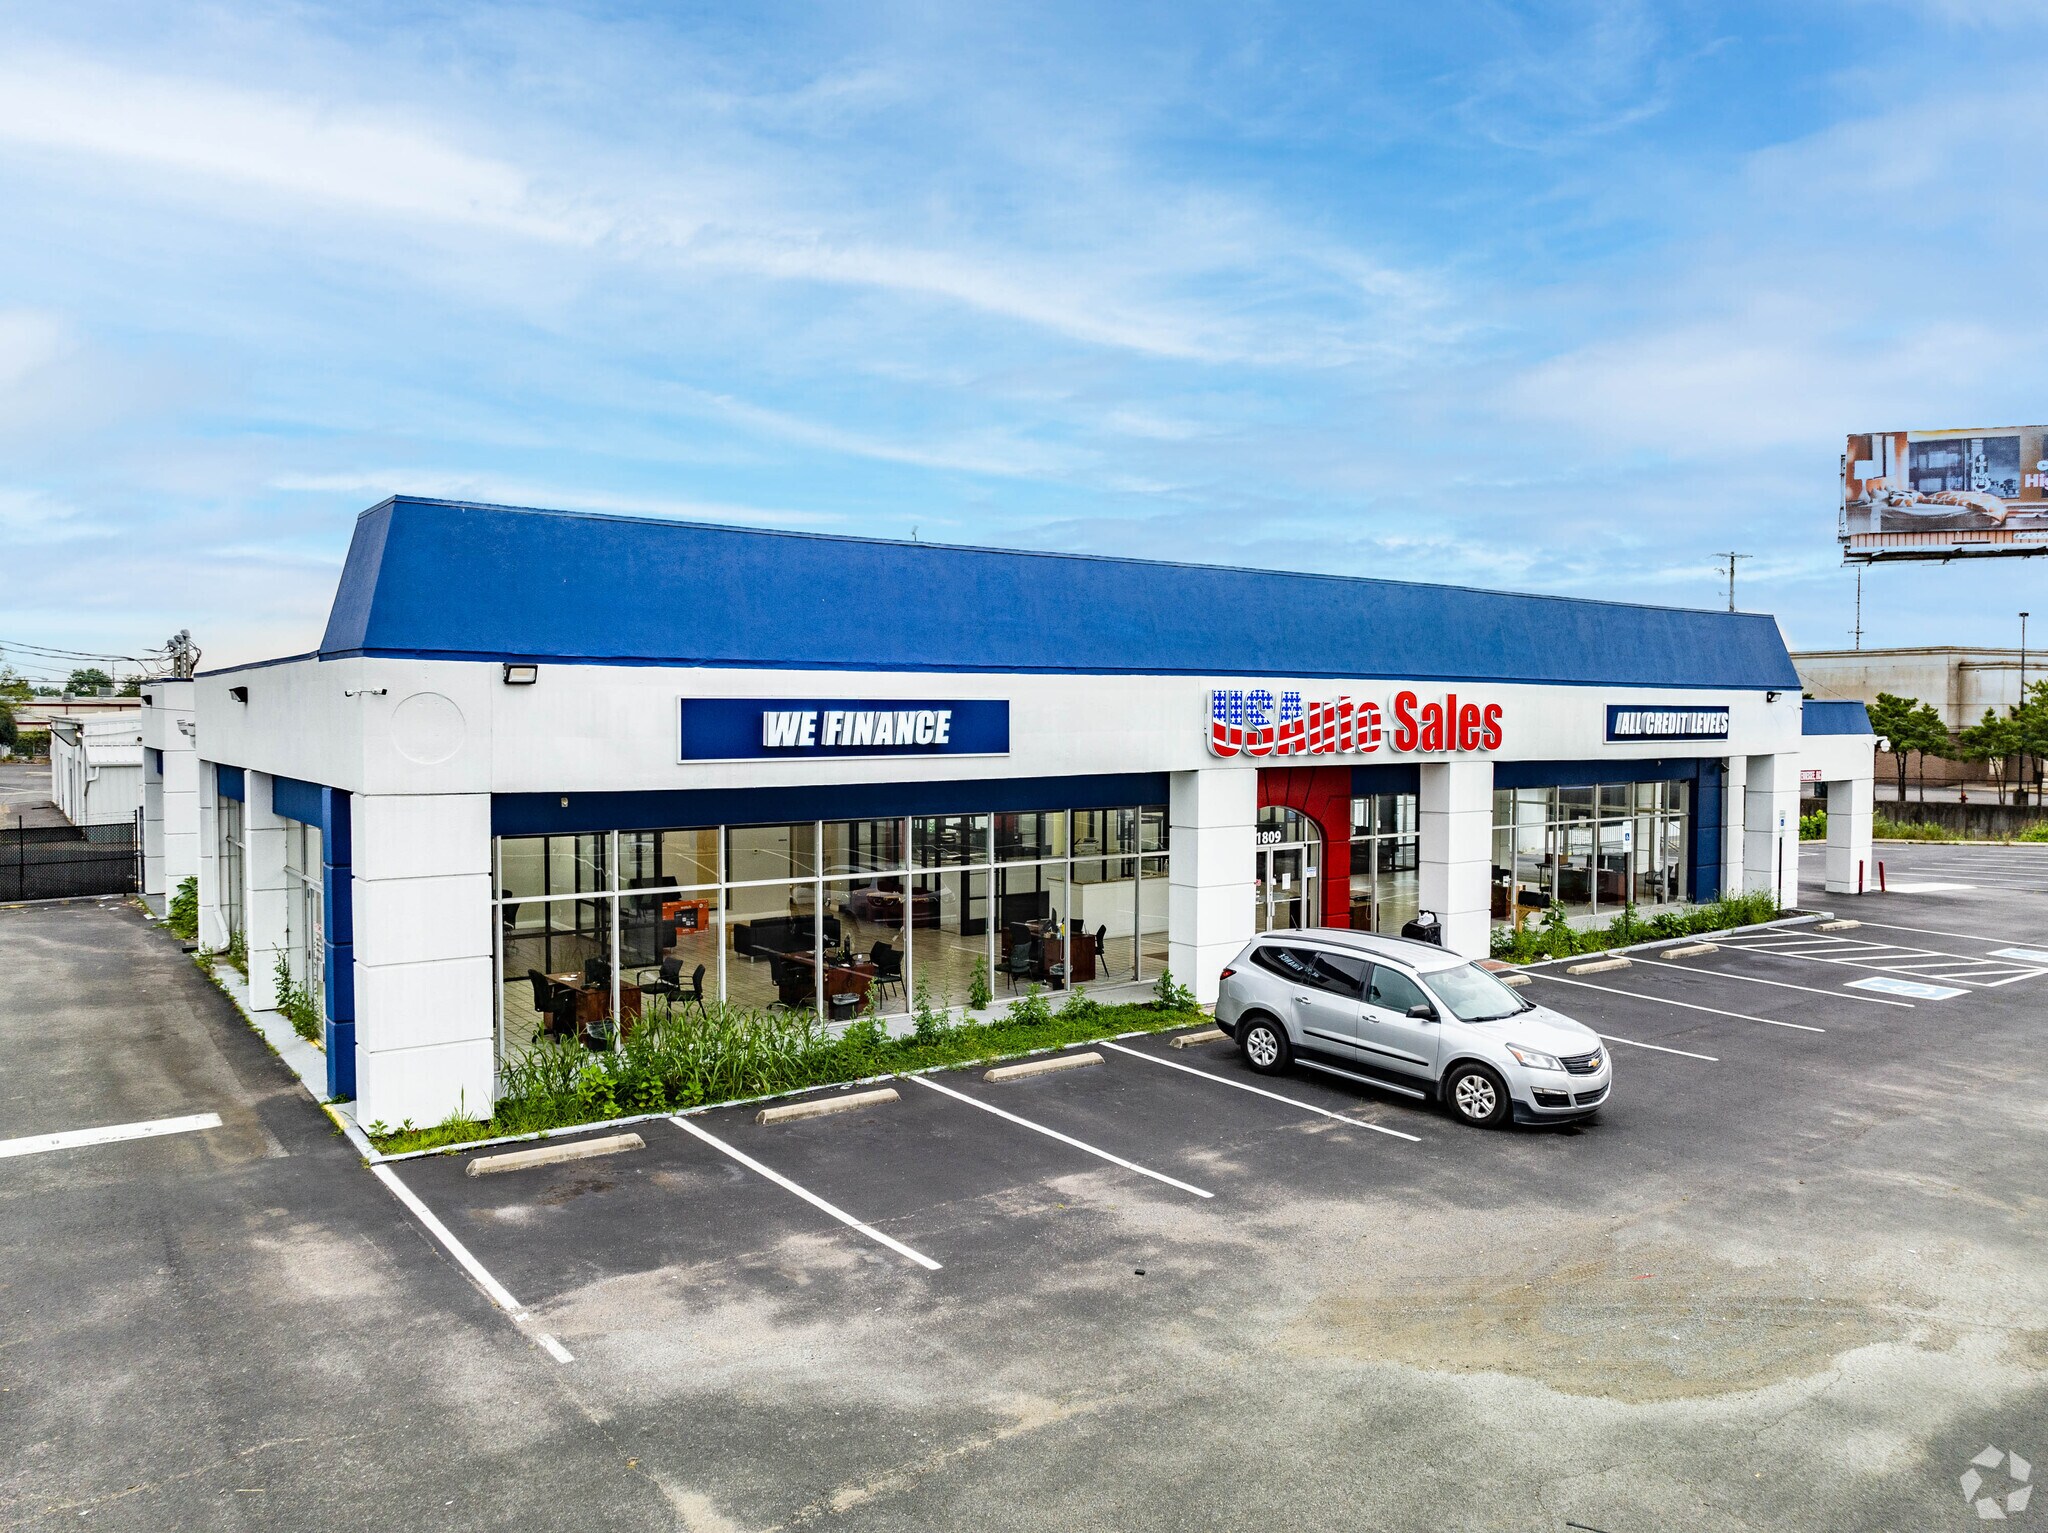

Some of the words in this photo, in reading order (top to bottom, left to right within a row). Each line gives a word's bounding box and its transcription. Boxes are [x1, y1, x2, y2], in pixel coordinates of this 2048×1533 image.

[763, 711, 817, 746] WE
[822, 710, 952, 746] FINANCE
[1392, 691, 1503, 753] Sales
[1616, 712, 1642, 734] ALL
[1643, 712, 1688, 734] CREDIT
[1690, 712, 1729, 734] LEVELS
[1257, 830, 1282, 844] 1809
